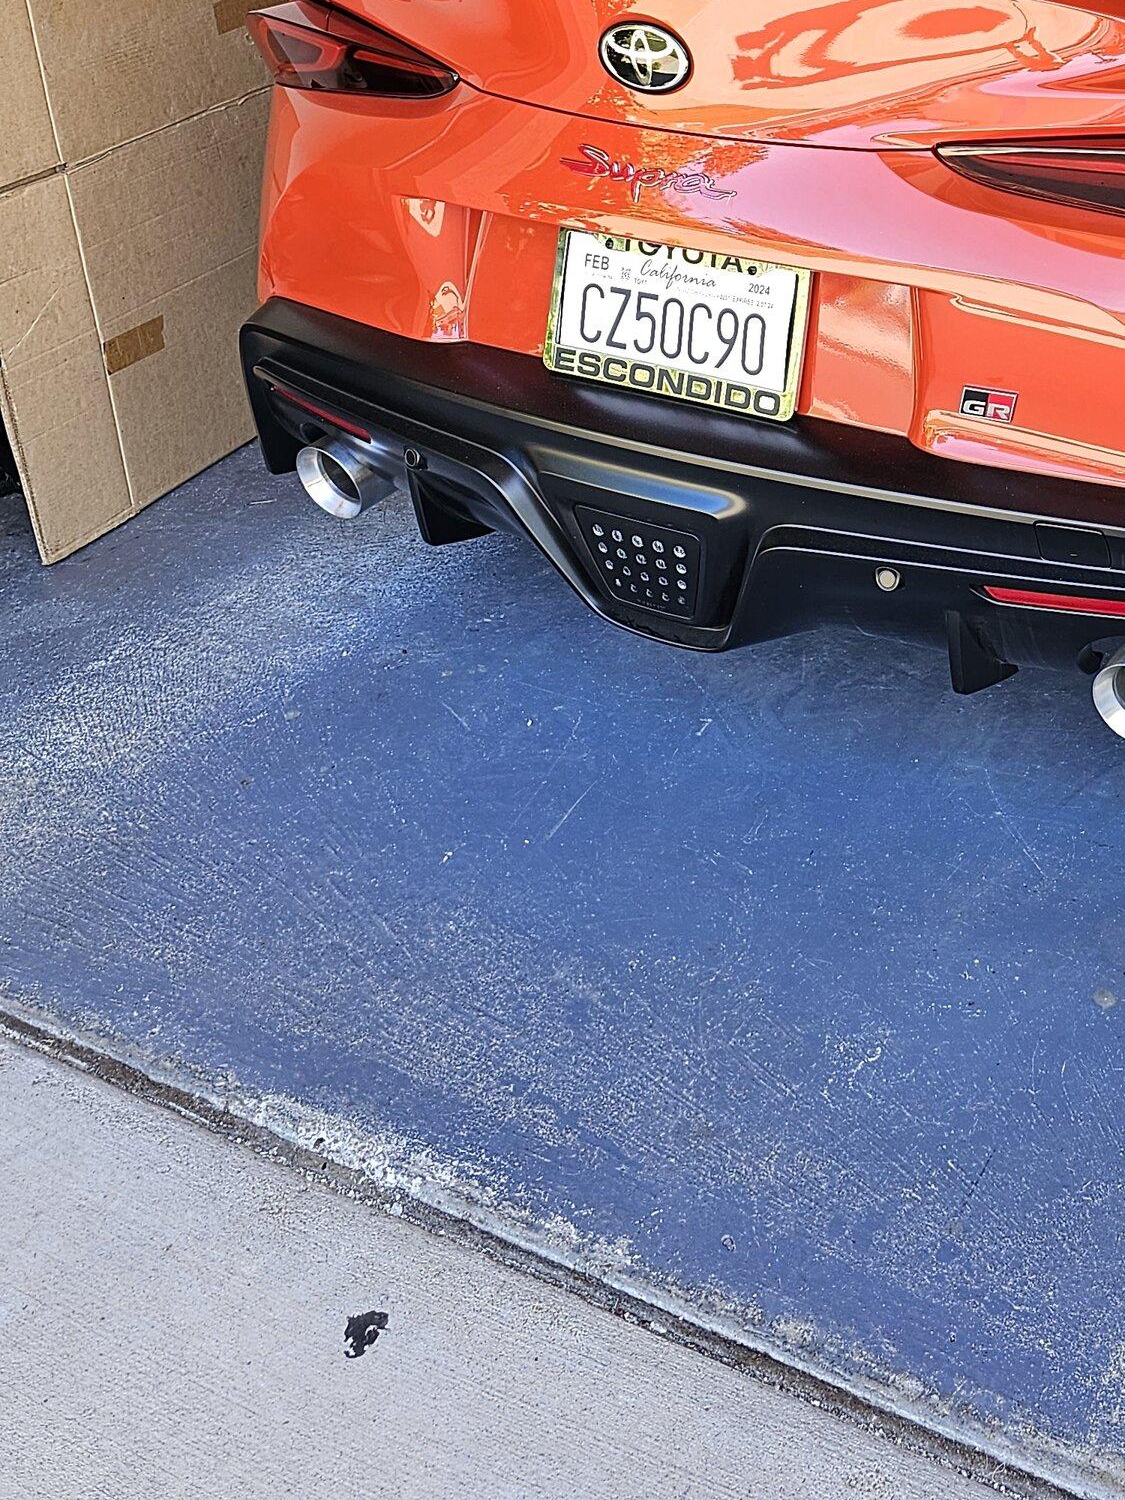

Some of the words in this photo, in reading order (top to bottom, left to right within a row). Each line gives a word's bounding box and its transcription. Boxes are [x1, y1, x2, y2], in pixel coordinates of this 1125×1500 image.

[559, 143, 737, 203] Supra
[584, 253, 610, 271] FEB
[640, 258, 717, 289] California
[748, 282, 771, 296] 2024
[579, 283, 766, 376] CZ50C90
[555, 349, 781, 417] ESCONDIDO
[962, 399, 1011, 420] GR
